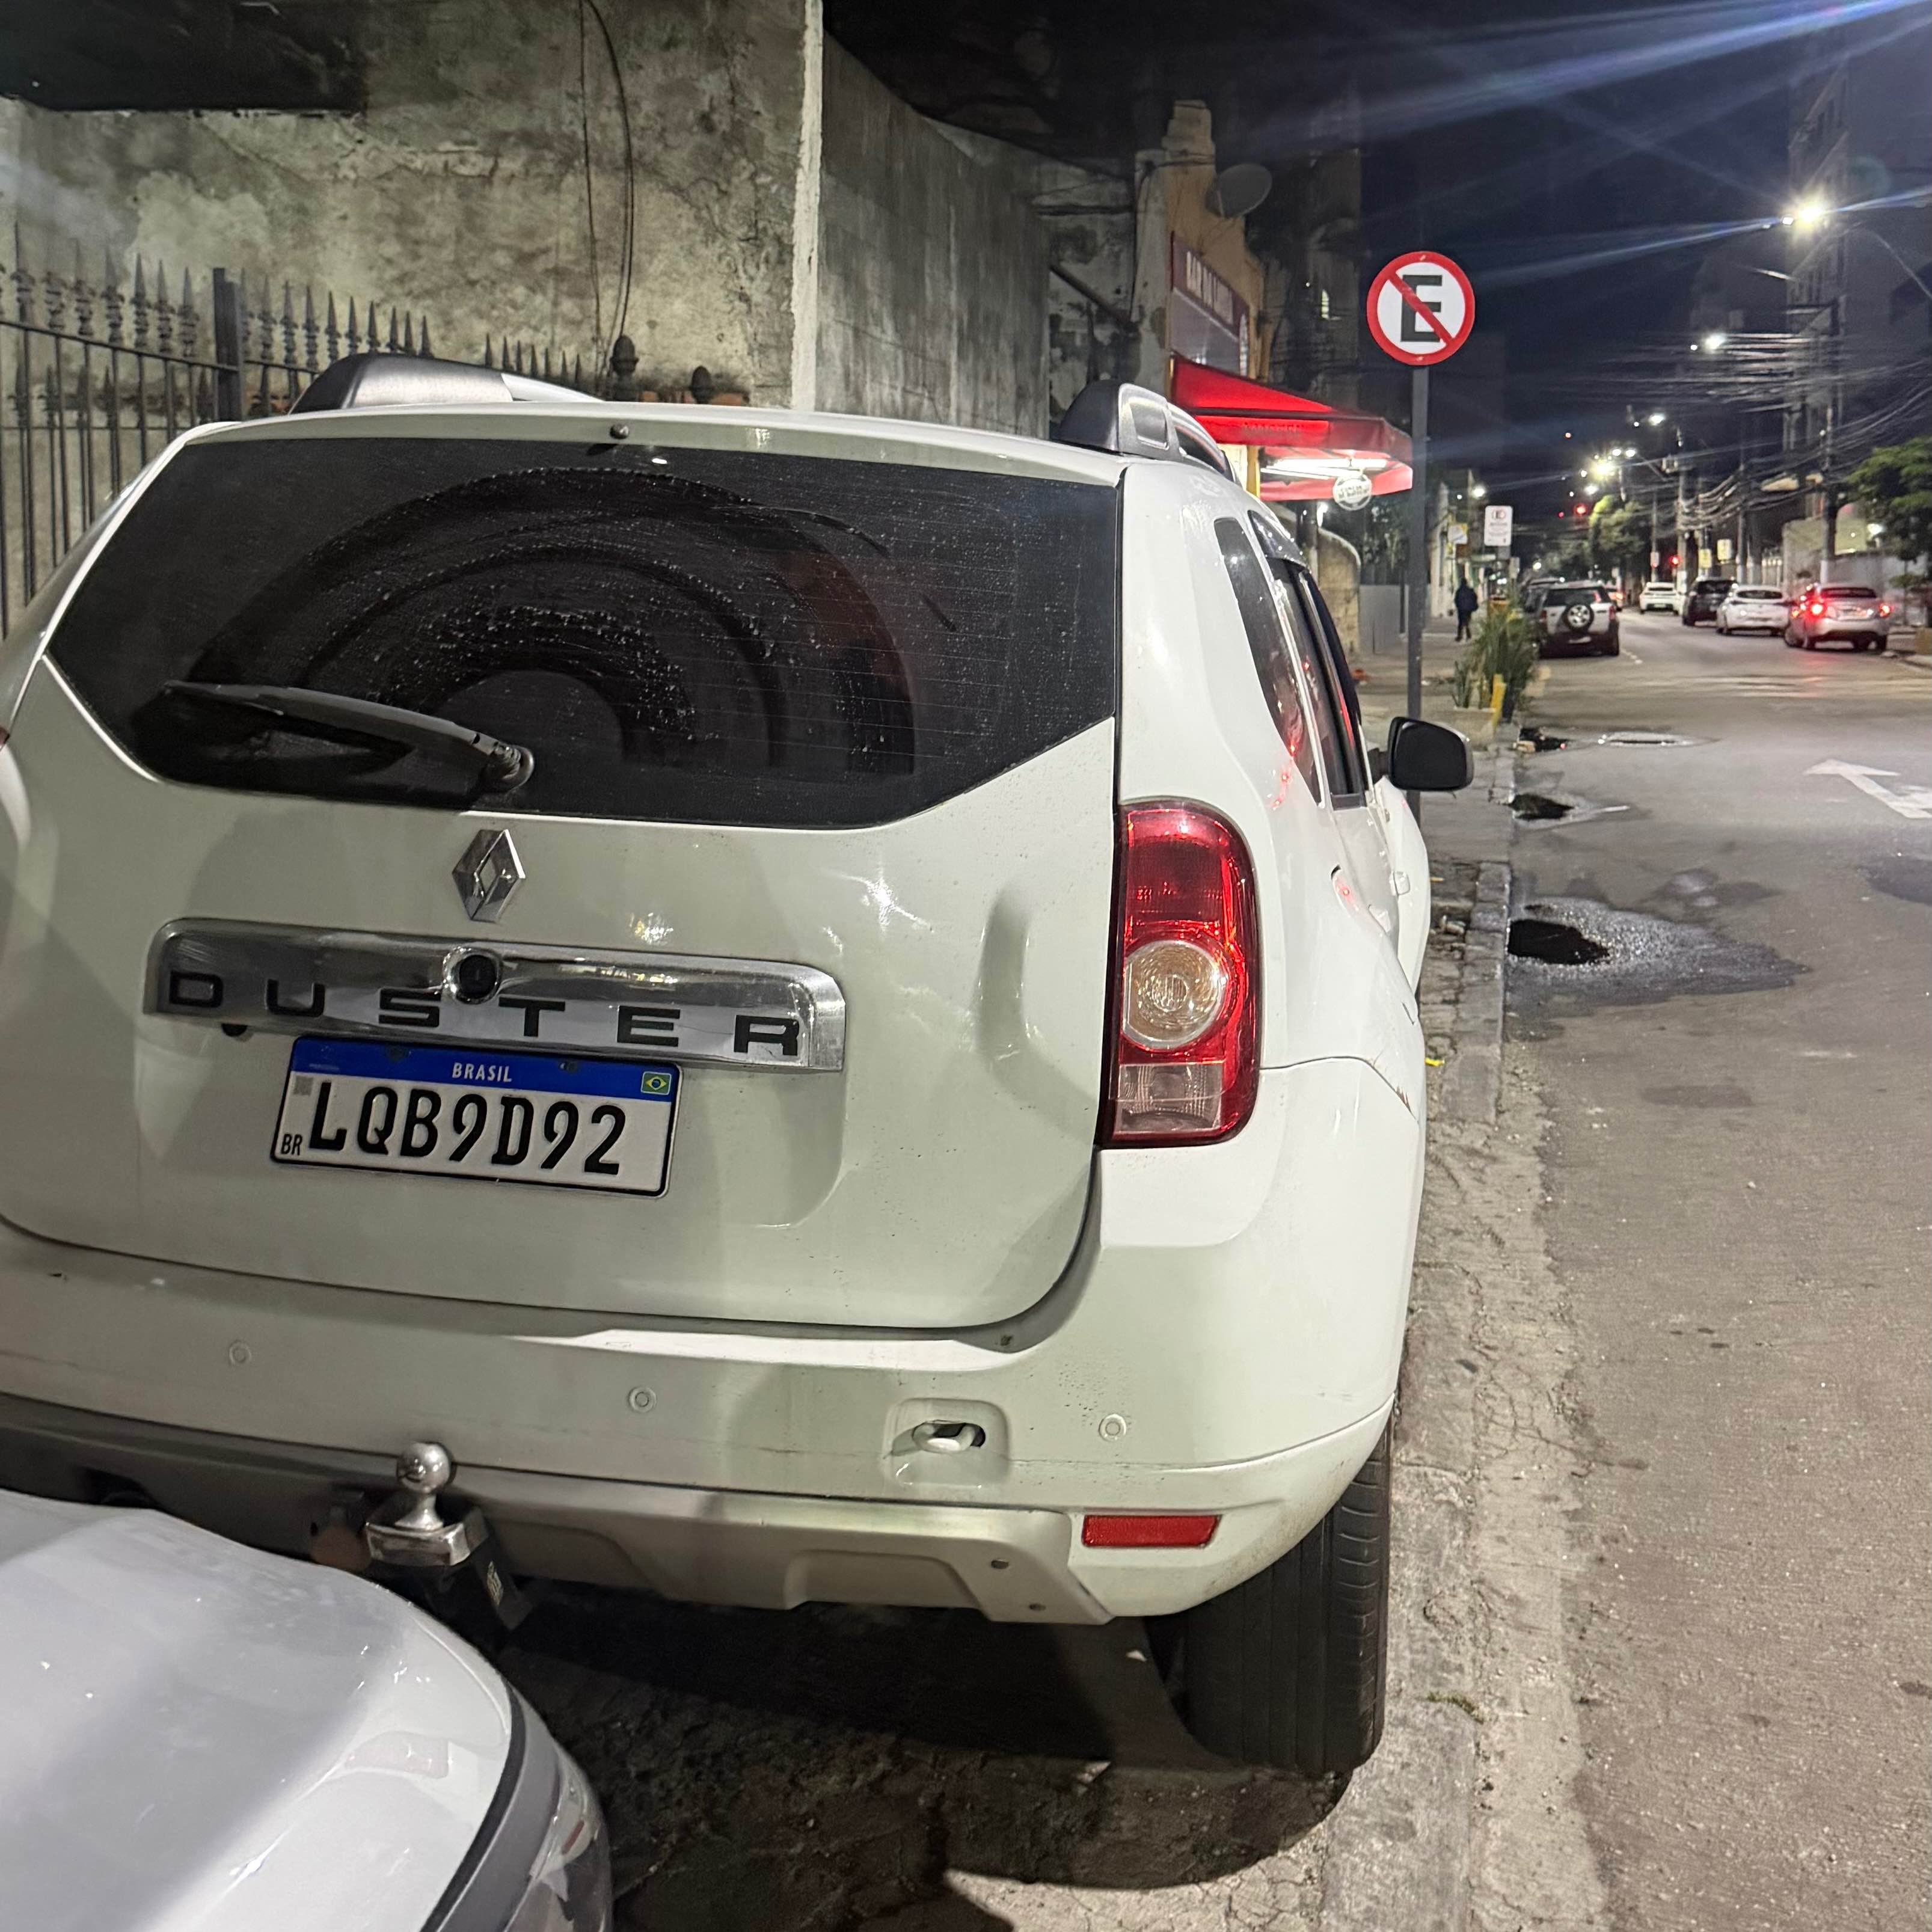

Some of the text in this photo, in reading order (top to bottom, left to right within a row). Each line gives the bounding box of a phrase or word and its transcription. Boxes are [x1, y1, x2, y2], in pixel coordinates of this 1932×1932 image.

[1402, 275, 1442, 342] E
[170, 971, 800, 1056] DUSTER
[452, 1062, 512, 1083] BRASIL
[280, 1133, 302, 1156] BR
[309, 1082, 625, 1175] LQB9D92
